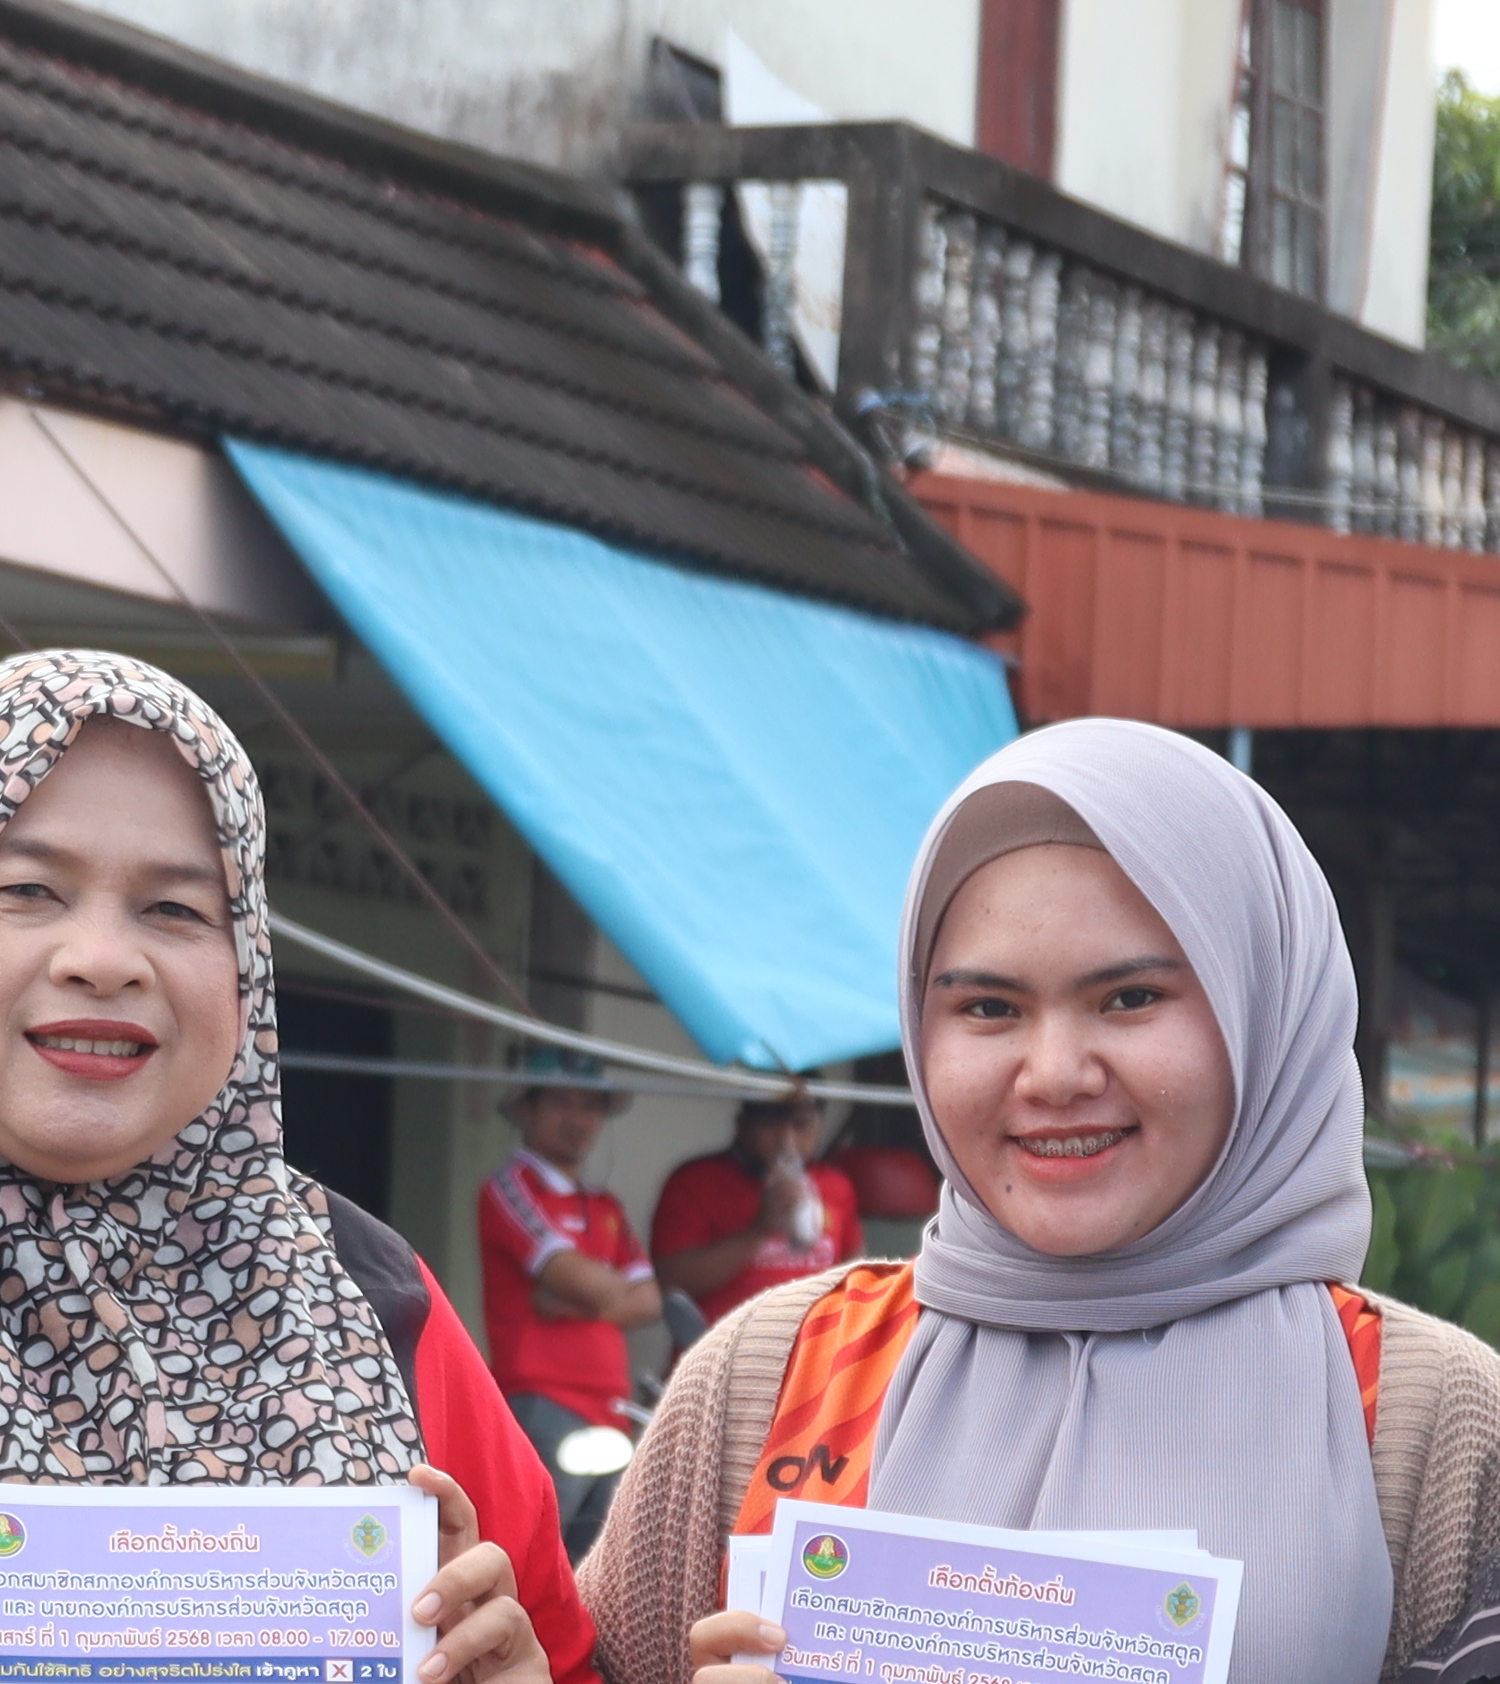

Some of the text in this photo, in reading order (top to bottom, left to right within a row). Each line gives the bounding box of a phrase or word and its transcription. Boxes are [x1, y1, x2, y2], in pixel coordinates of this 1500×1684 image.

[109, 1523, 260, 1552] เลือกตั้งท้องถิ่น
[926, 1567, 1075, 1608] เลือกตั้งท้องถิ่น
[3, 1596, 368, 1623] และ นายกองค์การบริหารส่วนจังหวัดสตูล
[39, 1624, 54, 1646] ที่
[75, 1626, 162, 1653] กุมภาพันธ์
[166, 1629, 211, 1647] 2568
[215, 1631, 254, 1646] เวลา
[259, 1629, 309, 1646] 08.00
[328, 1629, 377, 1647] 17.00
[380, 1631, 400, 1647] น.
[813, 1621, 845, 1640] และ
[98, 1662, 252, 1680] อย่างสุจริตโปร่งใส
[256, 1663, 319, 1680] เข้าคูหา
[360, 1665, 371, 1677] 2
[376, 1663, 396, 1677] ใบ
[781, 1641, 843, 1670] วันเสาร์
[843, 1650, 860, 1673] ที่
